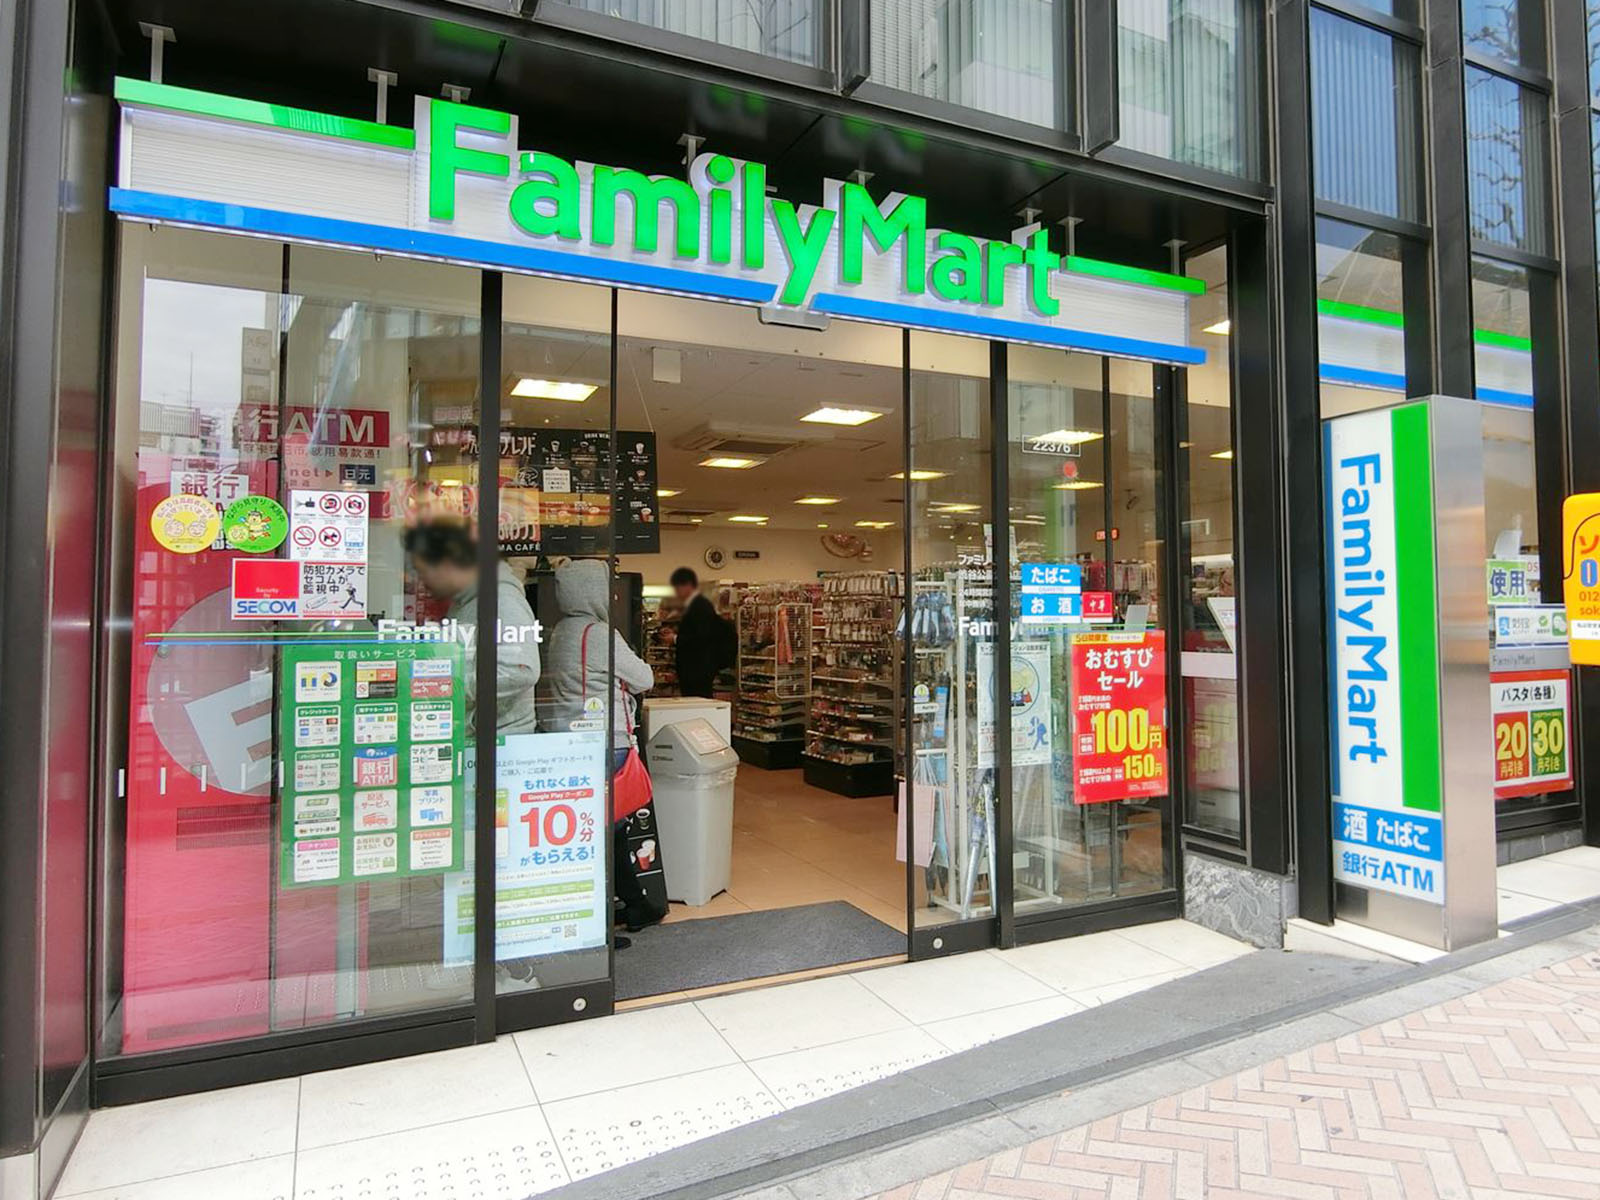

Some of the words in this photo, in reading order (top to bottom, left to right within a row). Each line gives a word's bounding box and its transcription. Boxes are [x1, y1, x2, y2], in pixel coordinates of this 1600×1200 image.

[429, 99, 1060, 316] FamilyMart
[1032, 440, 1071, 454] 22376
[303, 565, 366, 576] 防犯カメラで
[303, 575, 348, 585] セコムが
[1031, 567, 1072, 585] たばこ
[303, 584, 340, 595] 監視中
[1489, 568, 1526, 597] 使用
[237, 600, 297, 615] SECOM
[1031, 597, 1073, 614] お酒
[1338, 452, 1388, 764] FamilyMart
[378, 618, 543, 650] Familyart
[334, 649, 417, 659] 取扱いサービス
[1085, 648, 1154, 670] おむすび
[1097, 671, 1143, 691] セール
[1091, 708, 1149, 753] 100
[1496, 721, 1527, 760] 20
[1532, 718, 1564, 757] 30
[1122, 754, 1155, 779] 150
[361, 774, 389, 786] ATM
[524, 775, 591, 790] もれなく最大
[528, 791, 549, 801] Google
[520, 804, 577, 847] 10
[579, 811, 594, 827] %
[579, 827, 594, 843] 分
[1344, 807, 1368, 842] 酒
[1376, 816, 1431, 852] たばこ
[520, 846, 596, 867] がもらえる!
[1342, 851, 1434, 893] 銀行ATM
